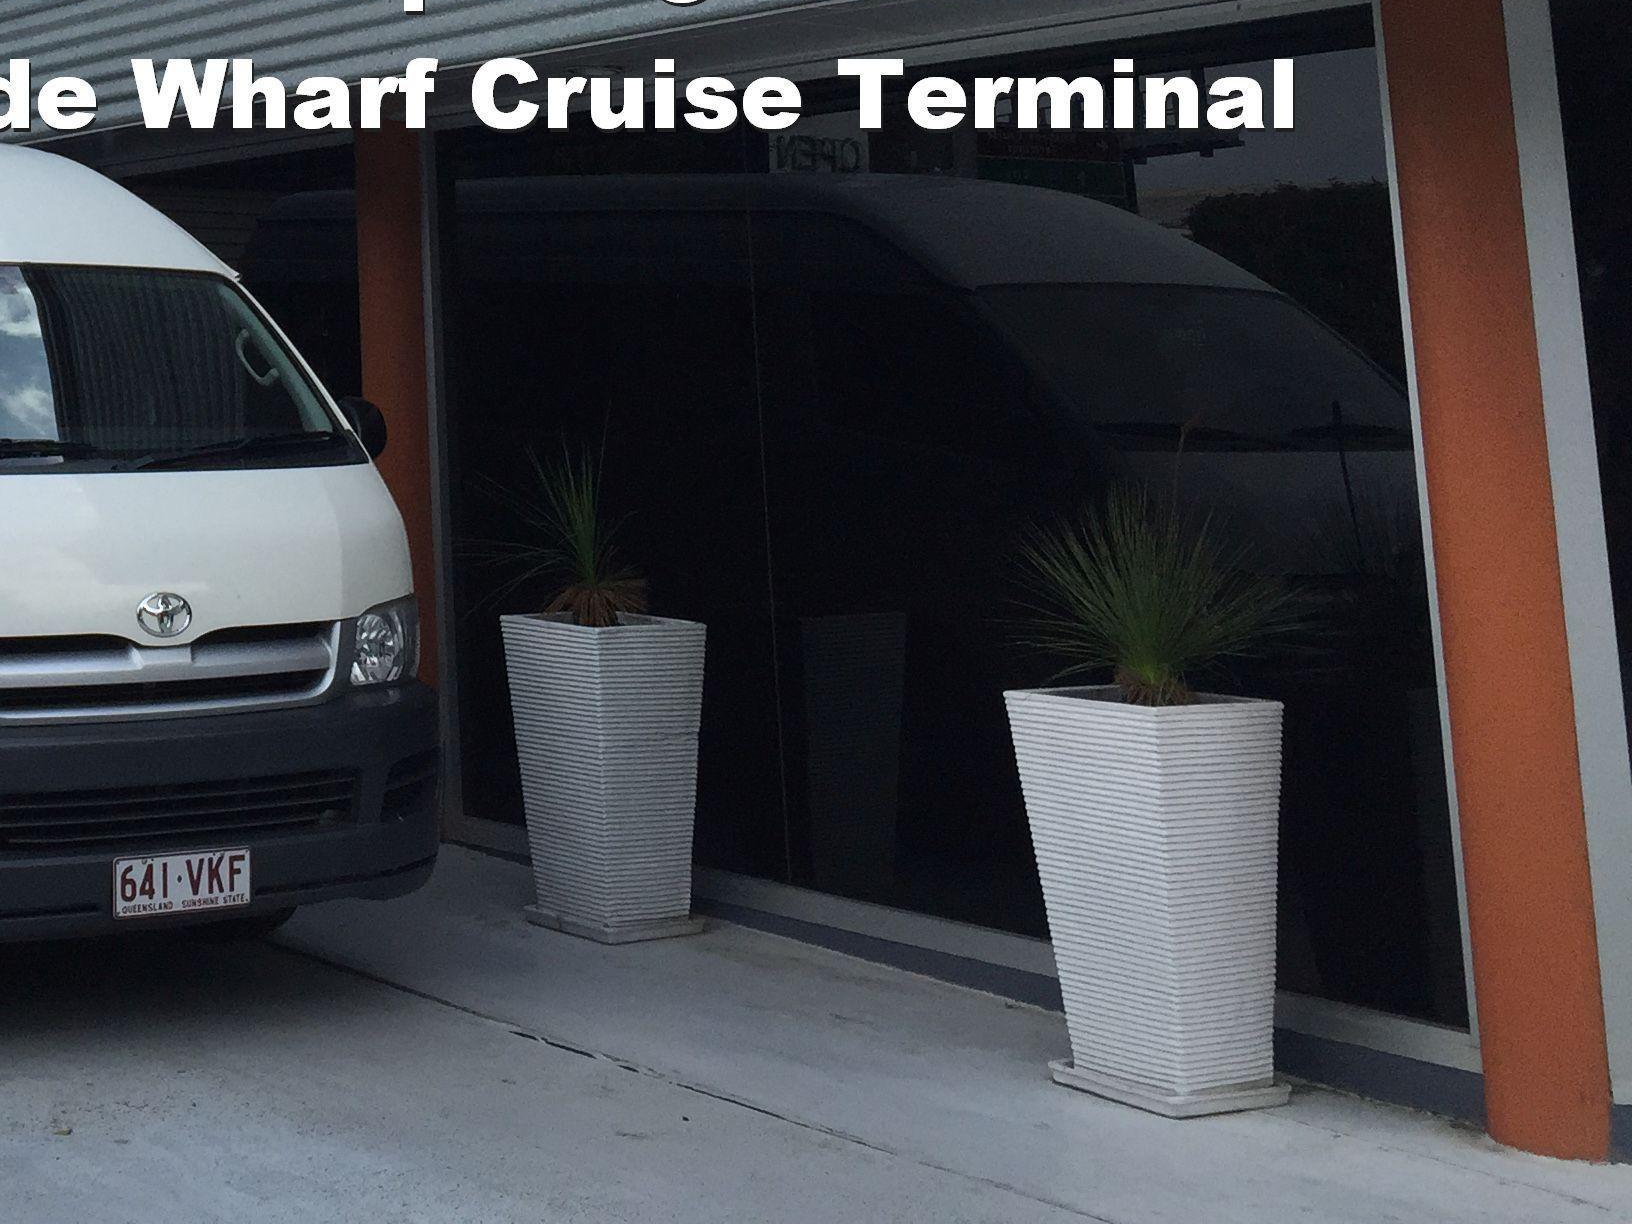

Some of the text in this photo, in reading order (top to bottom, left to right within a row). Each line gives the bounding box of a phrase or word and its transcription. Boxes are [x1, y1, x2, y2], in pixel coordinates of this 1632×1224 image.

[121, 893, 245, 915] QUEENSLAND SUNSHINE STATE
